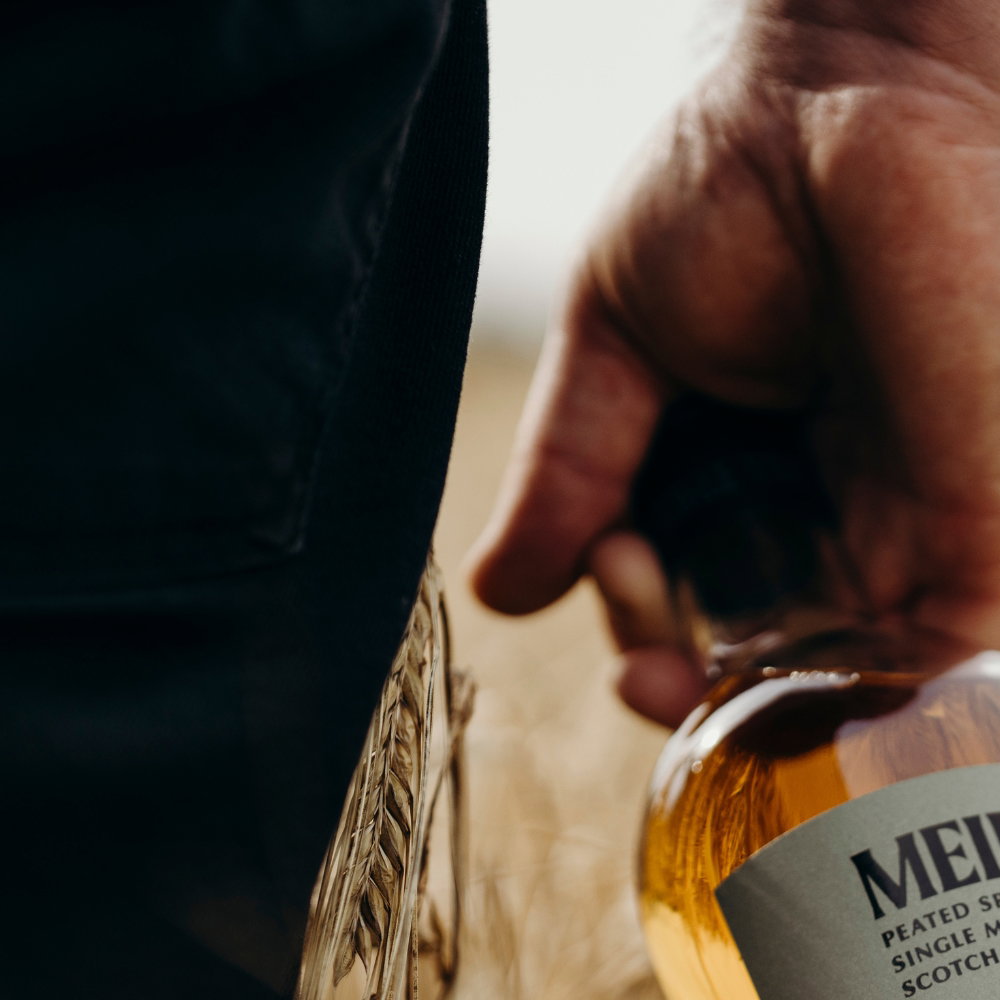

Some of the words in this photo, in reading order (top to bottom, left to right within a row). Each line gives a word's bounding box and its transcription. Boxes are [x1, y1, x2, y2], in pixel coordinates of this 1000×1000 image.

[880, 902, 970, 949] PEATED
[891, 928, 976, 974] SINGLE
[901, 949, 1000, 999] SCOTCH
